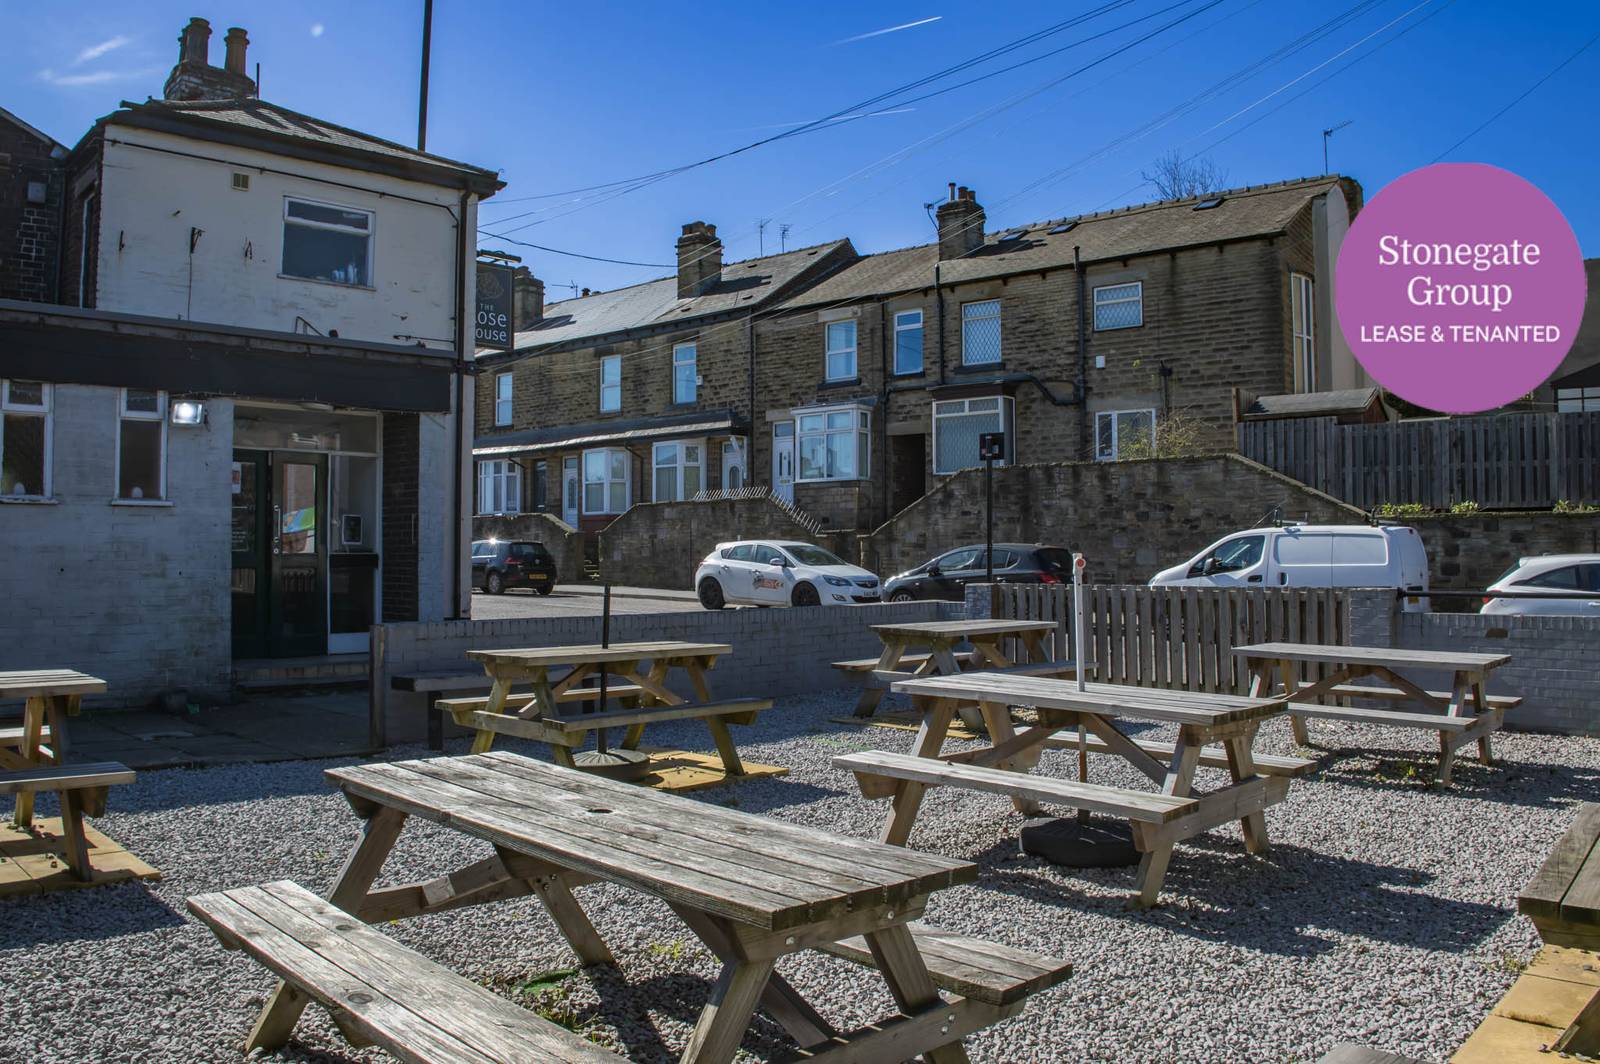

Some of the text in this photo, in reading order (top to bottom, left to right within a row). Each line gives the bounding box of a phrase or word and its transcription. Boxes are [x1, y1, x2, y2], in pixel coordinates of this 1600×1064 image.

[480, 303, 494, 311] THE
[476, 311, 506, 327] ose
[475, 328, 506, 341] ouse
